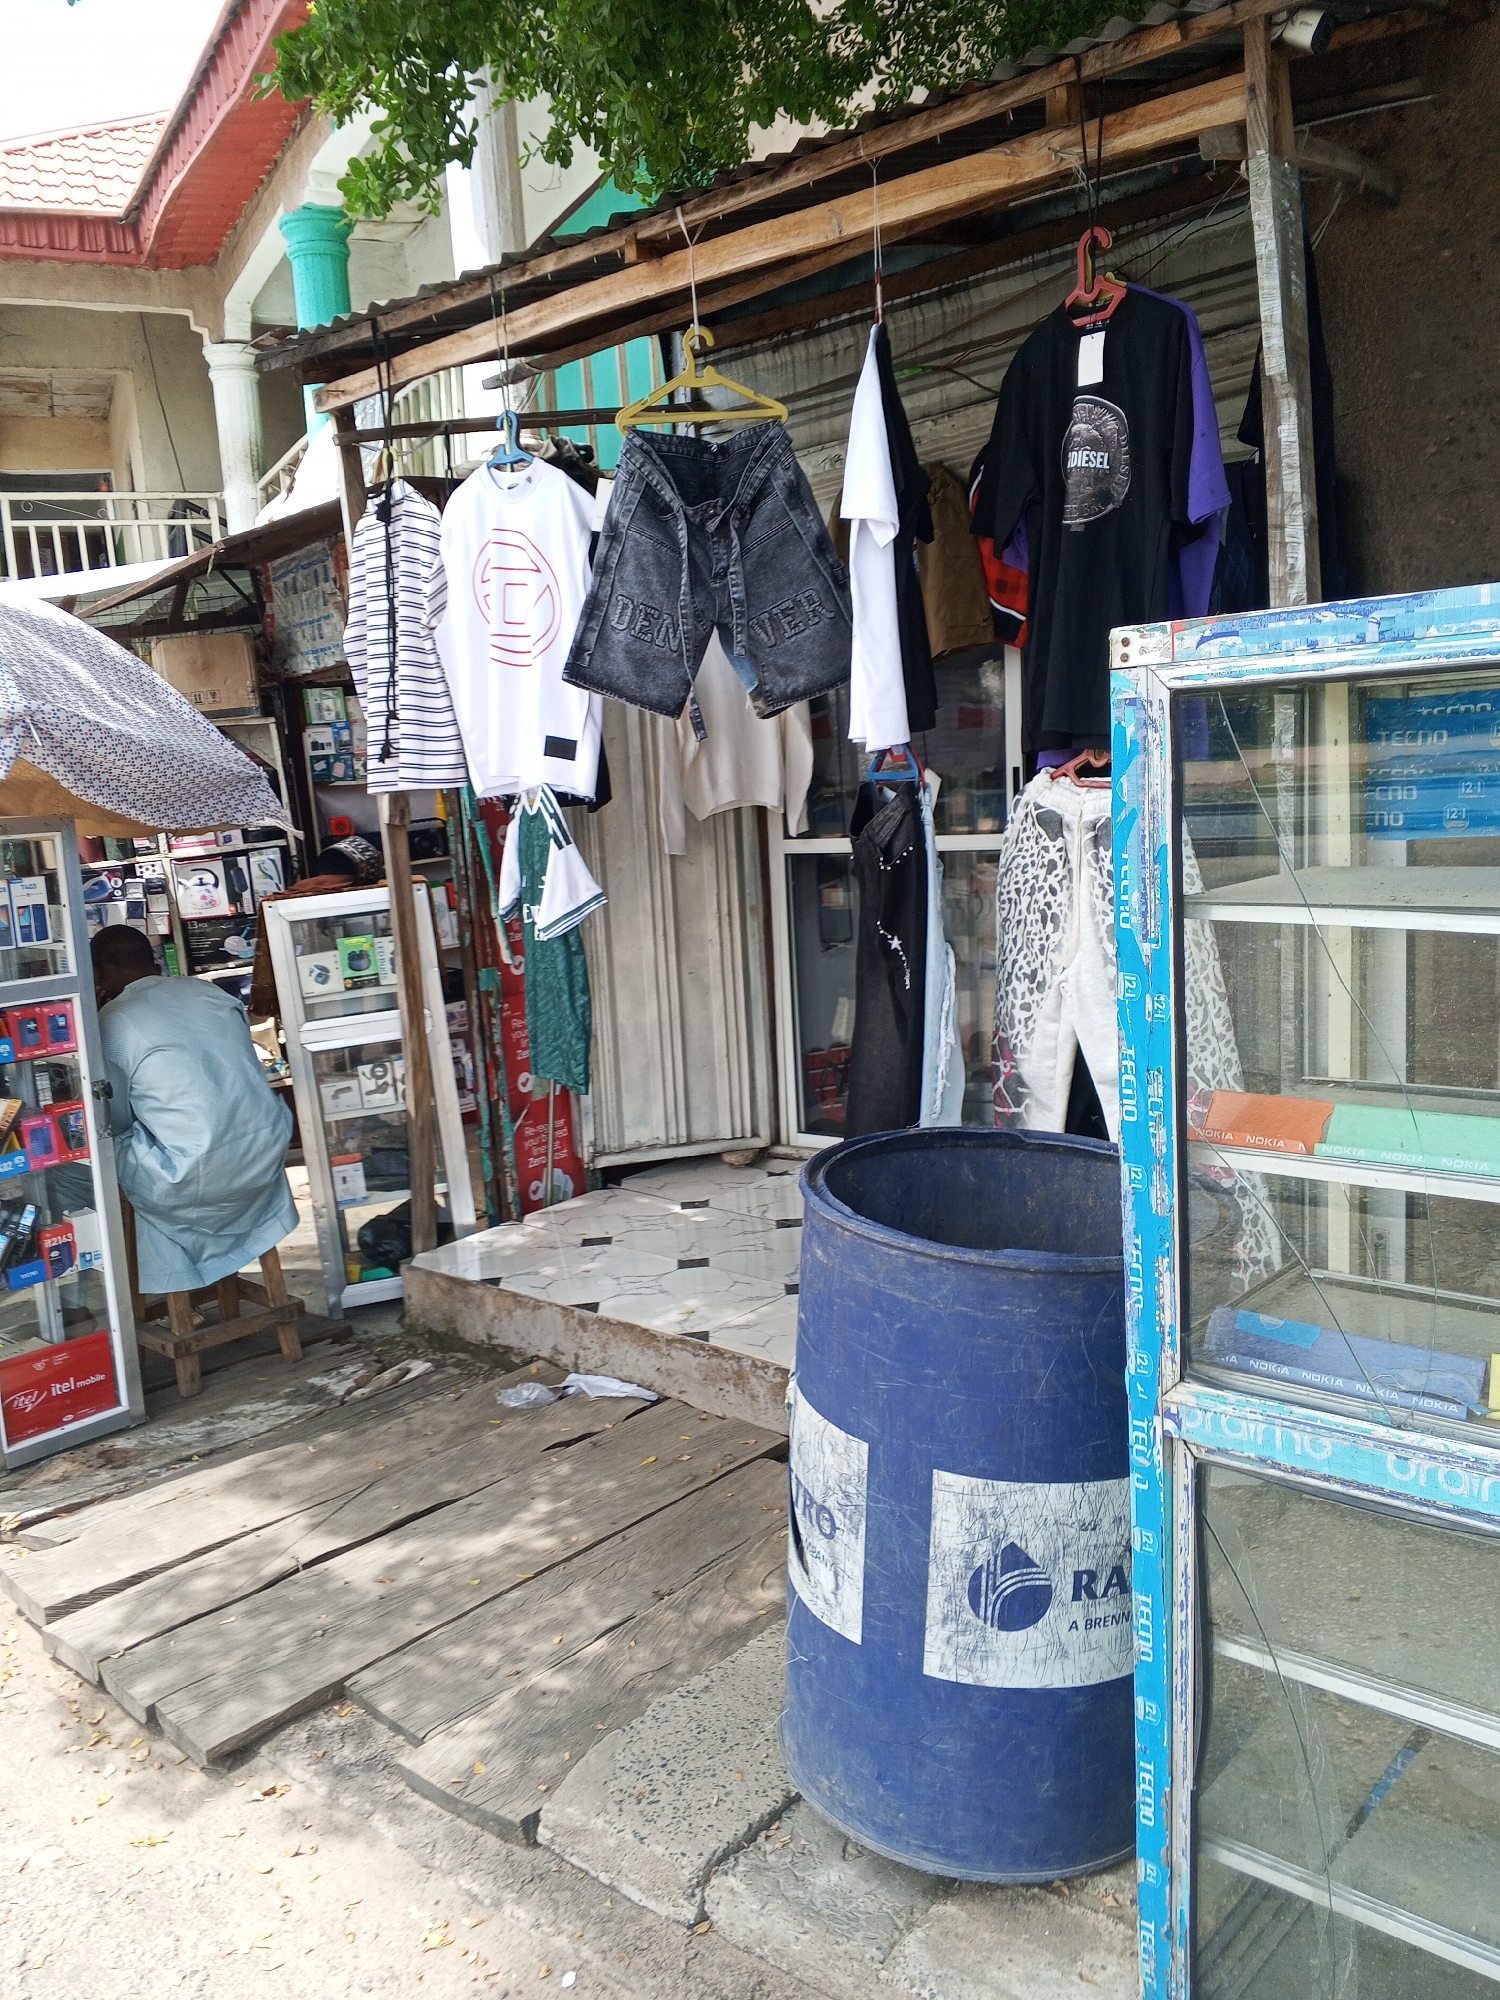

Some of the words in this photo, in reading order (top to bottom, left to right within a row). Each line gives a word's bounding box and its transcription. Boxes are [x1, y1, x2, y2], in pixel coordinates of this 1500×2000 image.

[1067, 450, 1110, 469] DIESEL
[610, 593, 684, 653] DEN
[748, 587, 836, 649] VER
[1377, 730, 1448, 746] TECNO
[1366, 785, 1418, 800] ECNO
[1121, 1043, 1139, 1123] TECNO
[1196, 1128, 1234, 1141] NOKIA
[1246, 1135, 1285, 1149] NOKIA
[1322, 1145, 1366, 1157] NOKIA
[1380, 1151, 1427, 1164] NOKIA
[1441, 1158, 1490, 1171] NOKIA
[50, 1377, 76, 1397] itel
[76, 1374, 106, 1389] mobile
[1249, 1360, 1290, 1376] NOKIA
[1301, 1371, 1344, 1388] NOKIA
[1355, 1383, 1399, 1400] NOKIA
[1412, 1396, 1459, 1413] NOKIA
[12, 1390, 39, 1408] itel
[1071, 1564, 1131, 1603] RA
[1067, 1620, 1079, 1633] A
[1084, 1610, 1131, 1631] BRENN
[1138, 1593, 1154, 1663] TECNO
[1139, 1760, 1155, 1827] TECNO
